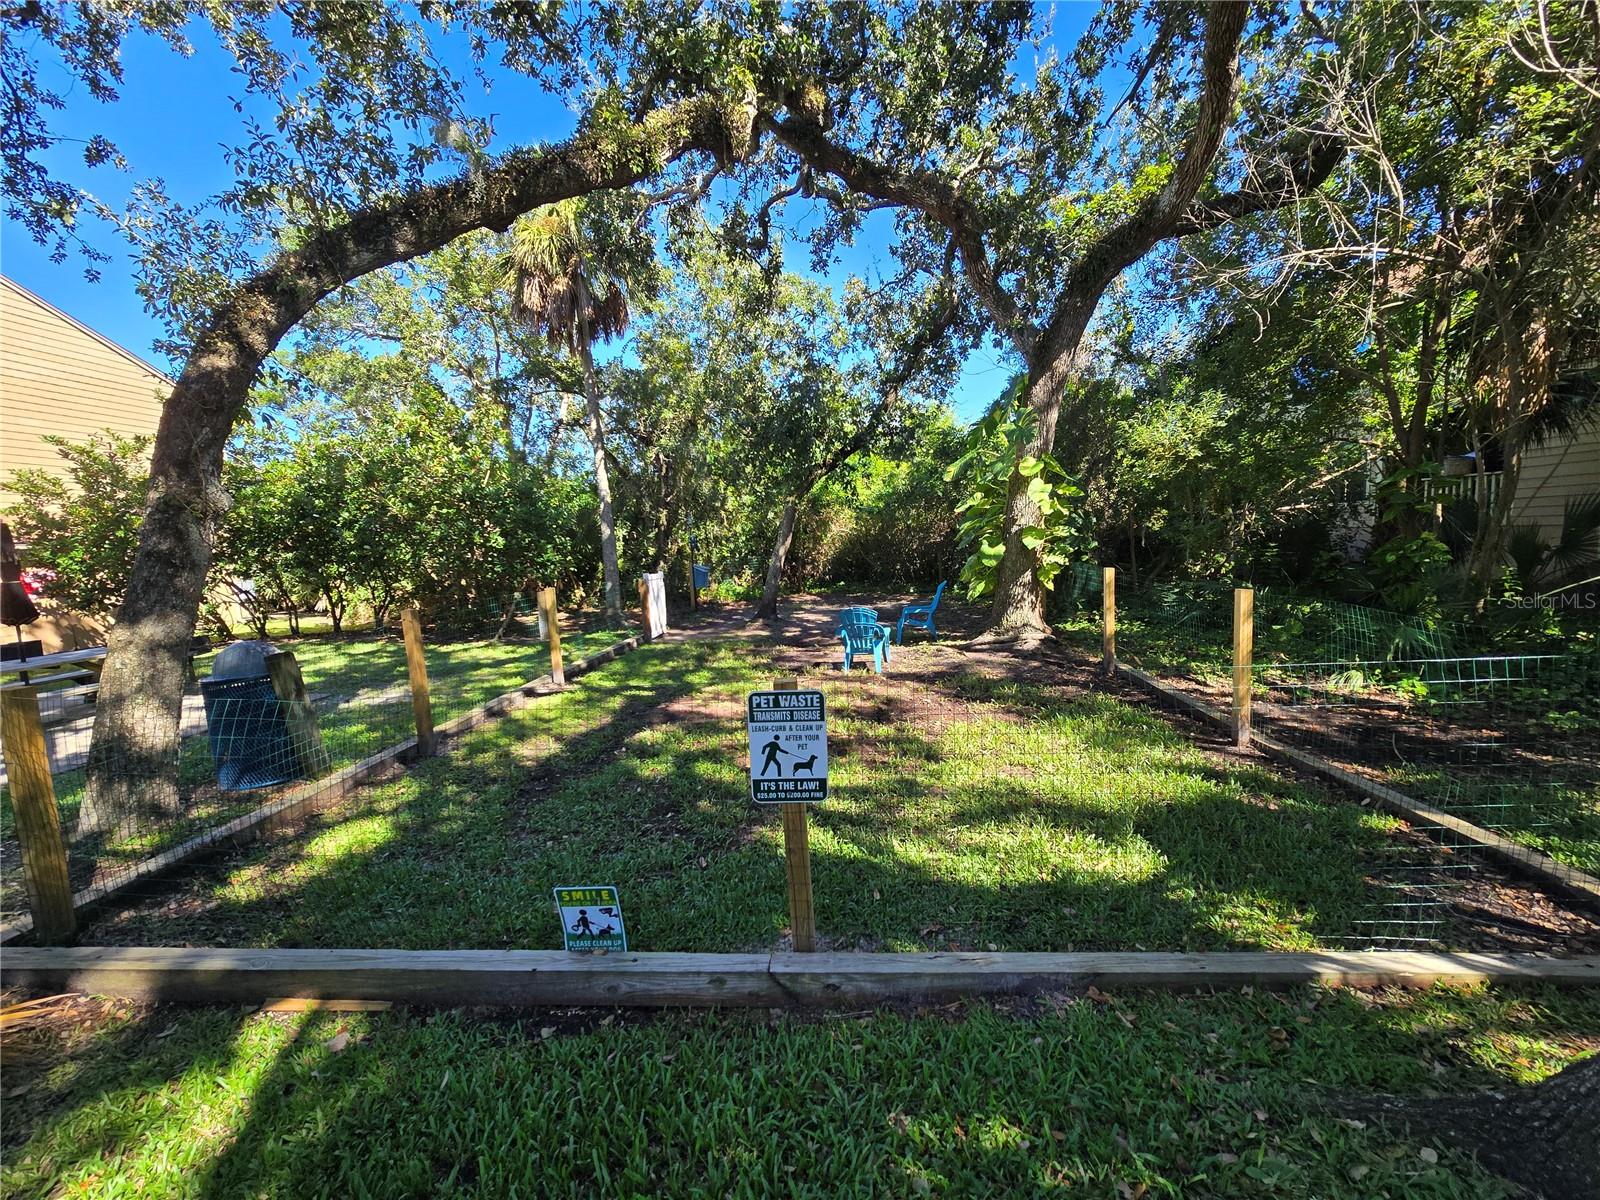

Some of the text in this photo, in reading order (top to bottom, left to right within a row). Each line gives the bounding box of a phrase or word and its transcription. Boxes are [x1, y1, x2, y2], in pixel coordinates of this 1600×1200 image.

[752, 694, 820, 708] PET WASTE
[753, 710, 820, 720] TRANSMITS DISEASE
[752, 724, 786, 732] LEASH-CURB
[760, 781, 820, 790] IT'S THE LAW!
[562, 890, 610, 900] SMILE
